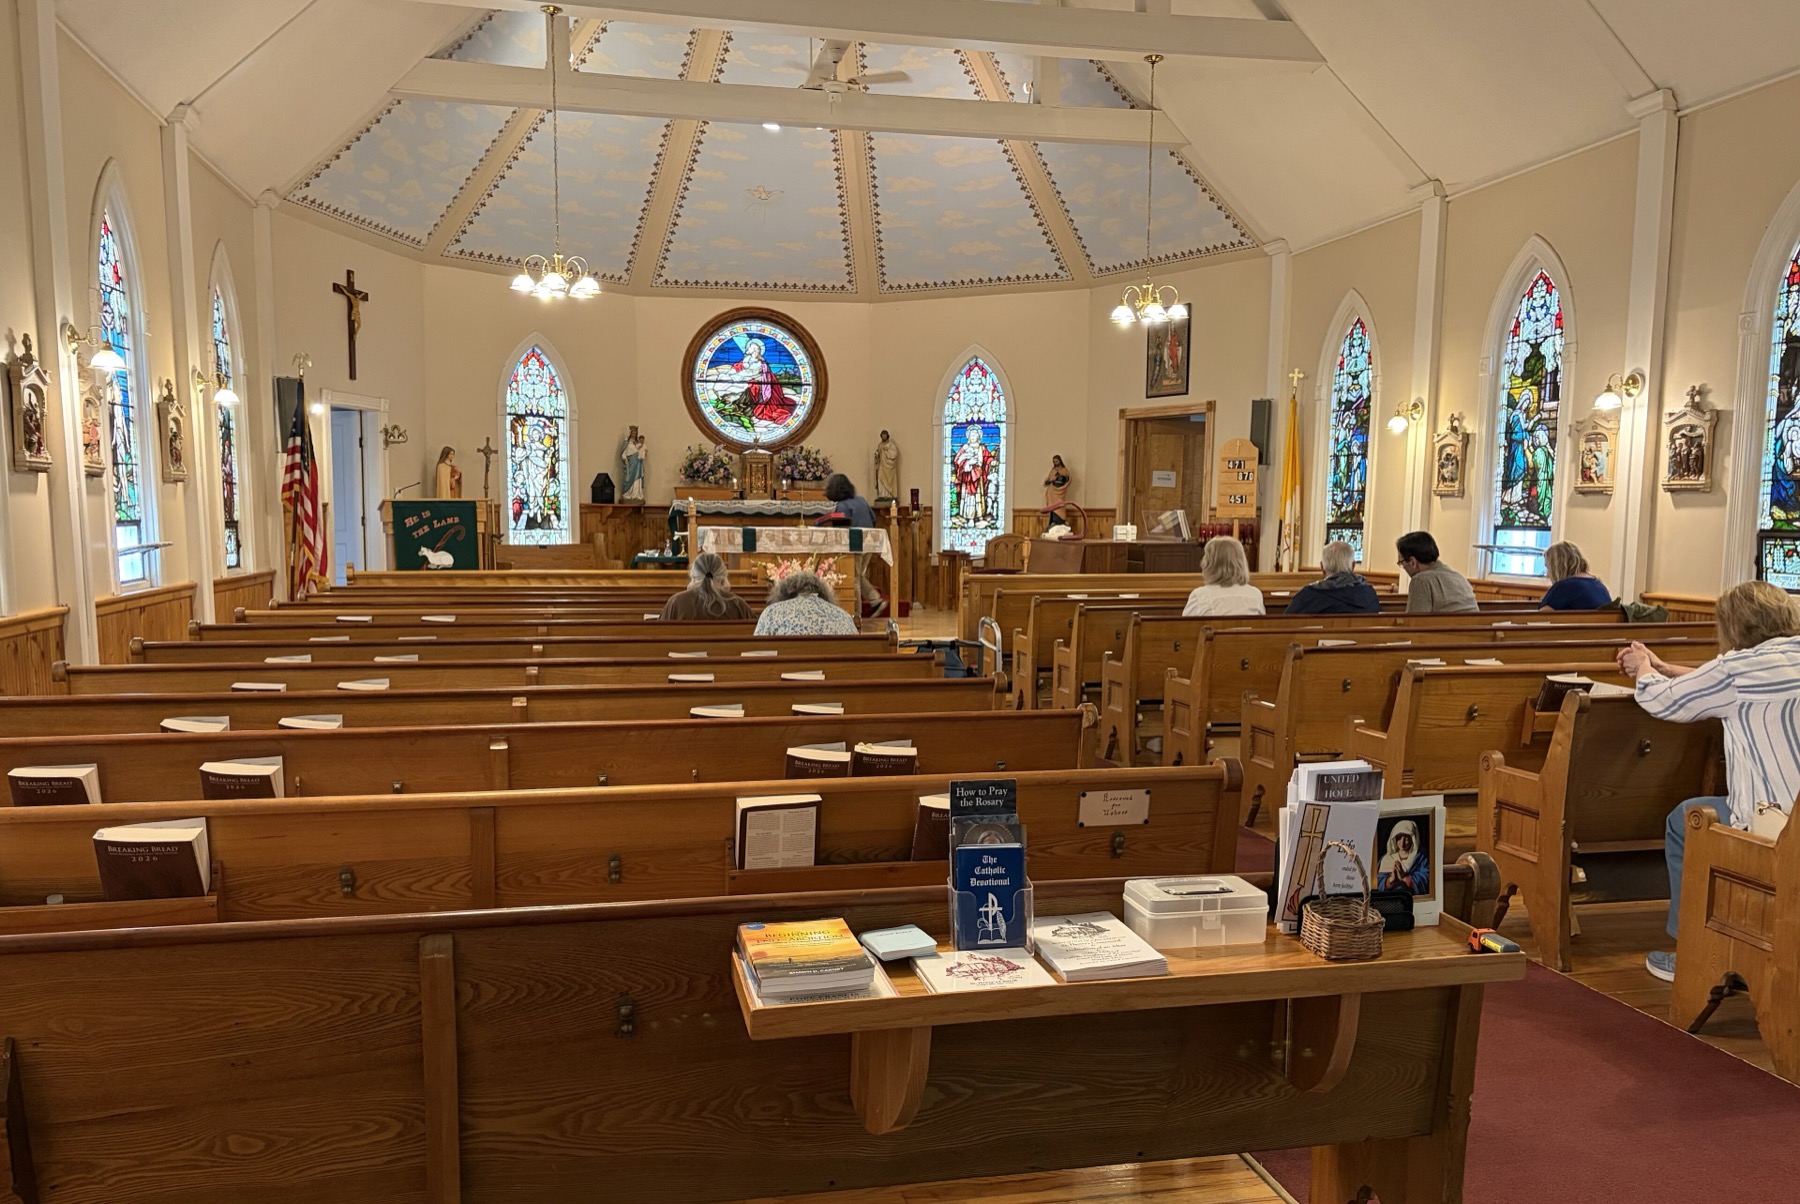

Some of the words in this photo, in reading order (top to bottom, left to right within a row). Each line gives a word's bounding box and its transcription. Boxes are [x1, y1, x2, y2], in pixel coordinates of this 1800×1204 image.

[1229, 460, 1244, 469] 471
[1238, 472, 1254, 480] 870
[1230, 495, 1246, 503] 451
[208, 775, 239, 783] BREAKING
[1323, 774, 1360, 784] UNITED
[956, 787, 976, 797] How
[978, 788, 987, 796] to
[989, 786, 1008, 796] Pray
[1324, 788, 1353, 798] HOPE
[960, 798, 973, 807] the
[975, 797, 1004, 807] Rosary
[107, 845, 149, 853] BREAKING
[982, 855, 998, 865] The
[974, 866, 1006, 876] Catholic
[970, 877, 1010, 887] Devotional
